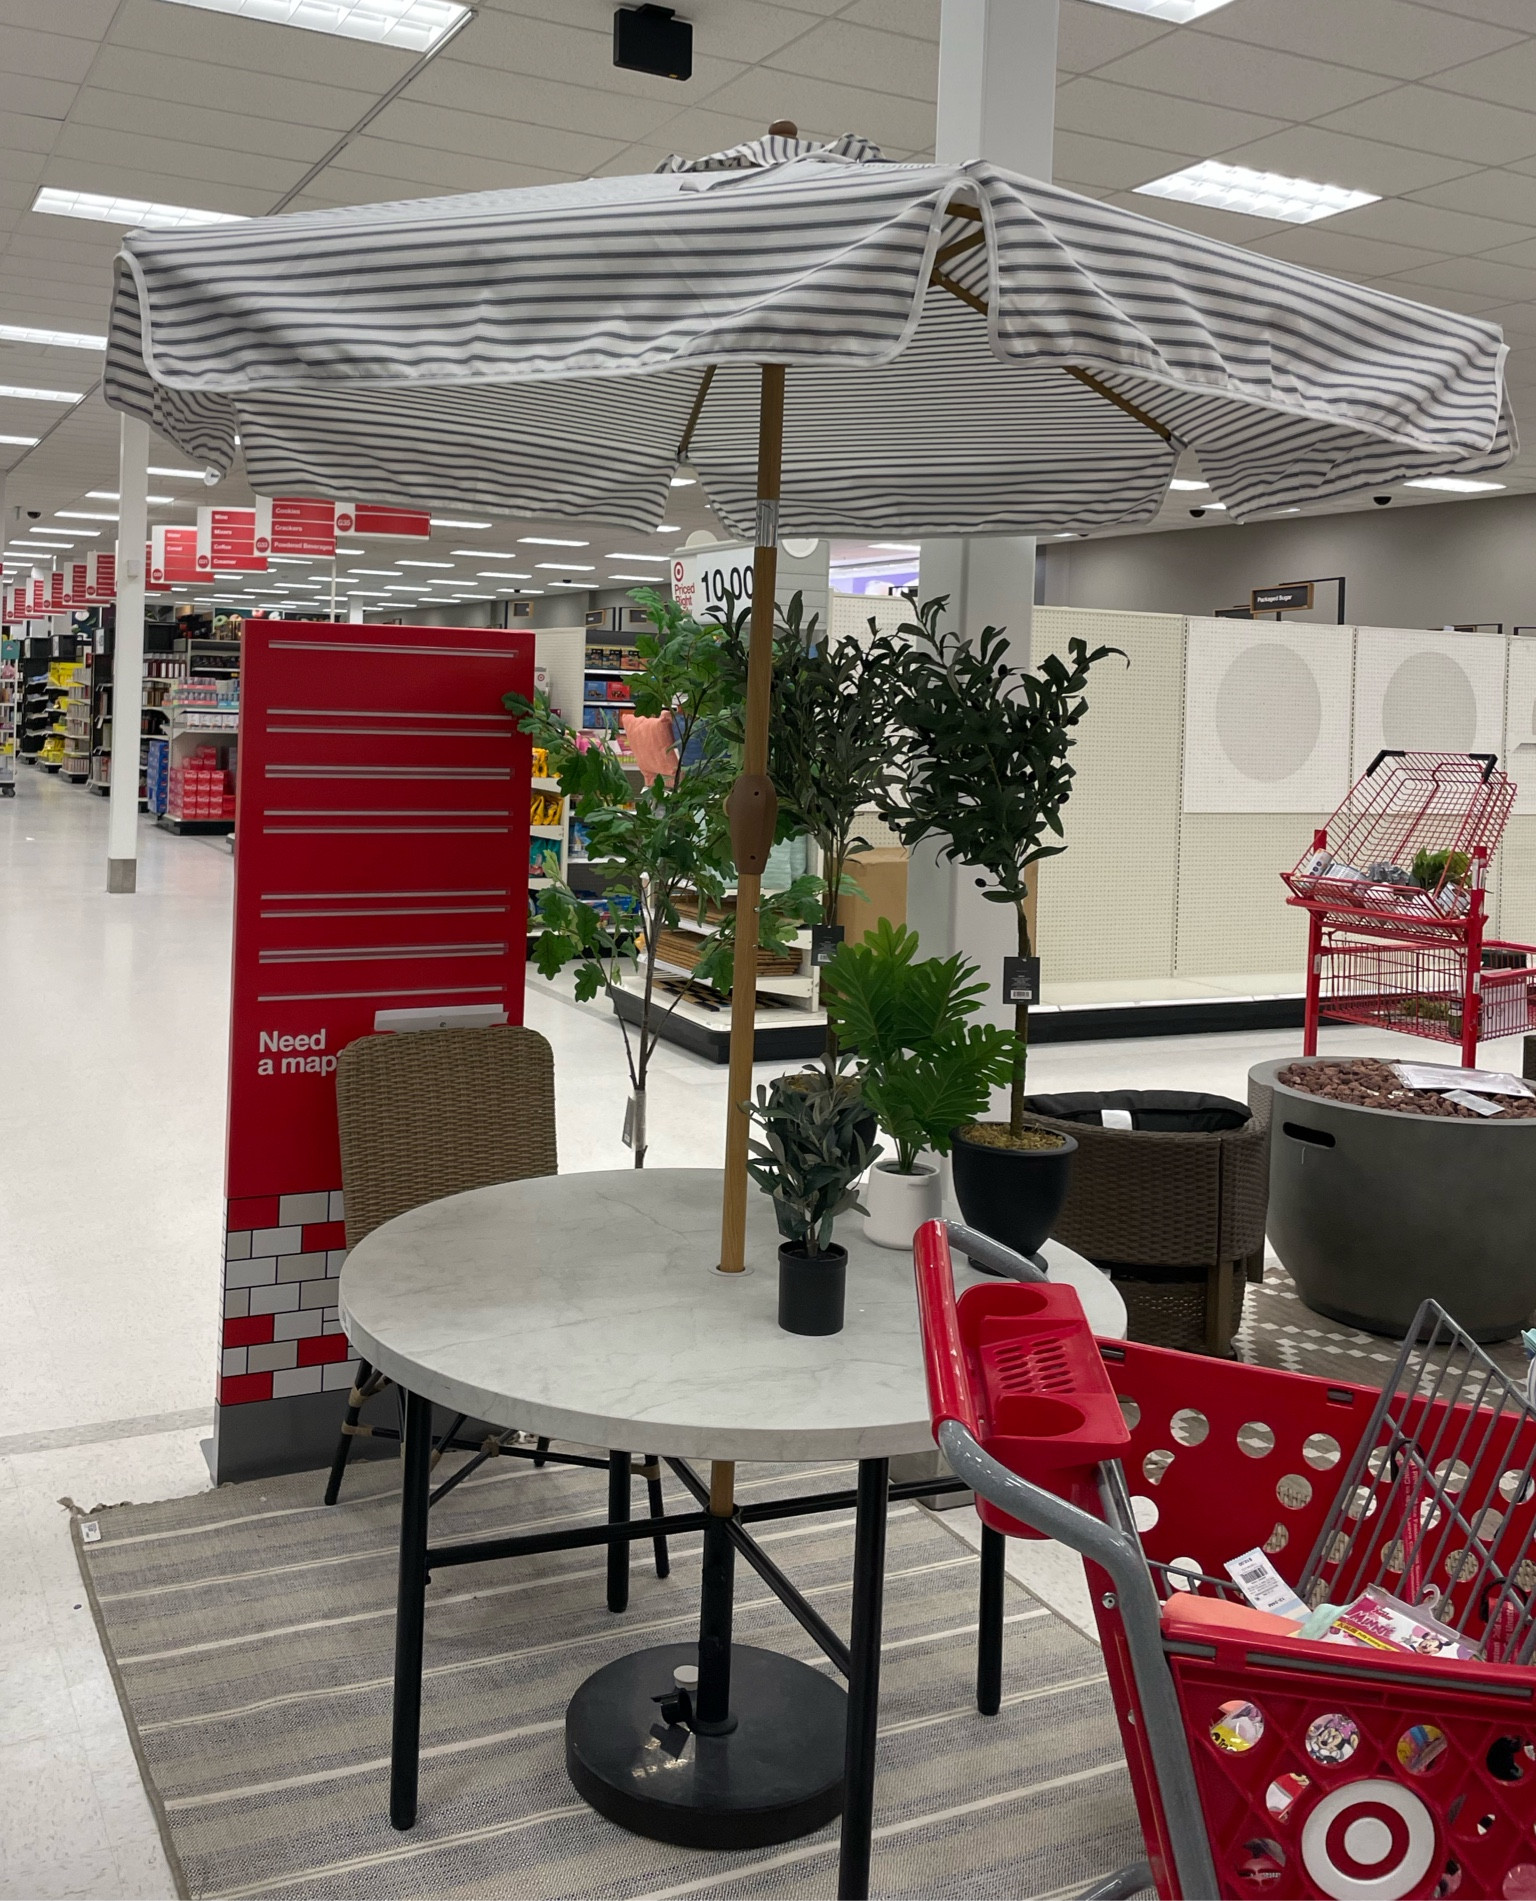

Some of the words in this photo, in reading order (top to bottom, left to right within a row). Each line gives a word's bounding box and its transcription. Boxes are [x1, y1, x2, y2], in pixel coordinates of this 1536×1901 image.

[275, 507, 301, 515] Cookies
[274, 524, 303, 532] Crackers
[274, 541, 303, 549] Powdered
[303, 542, 333, 551] Beverages
[675, 583, 695, 595] Priced
[675, 594, 693, 609] Right
[1257, 595, 1278, 603] Packaged
[1279, 594, 1292, 602] Sugar
[259, 1028, 326, 1053] Need
[257, 1058, 274, 1076] a
[281, 1049, 345, 1077] map
[1349, 1610, 1396, 1637] MINNIE
